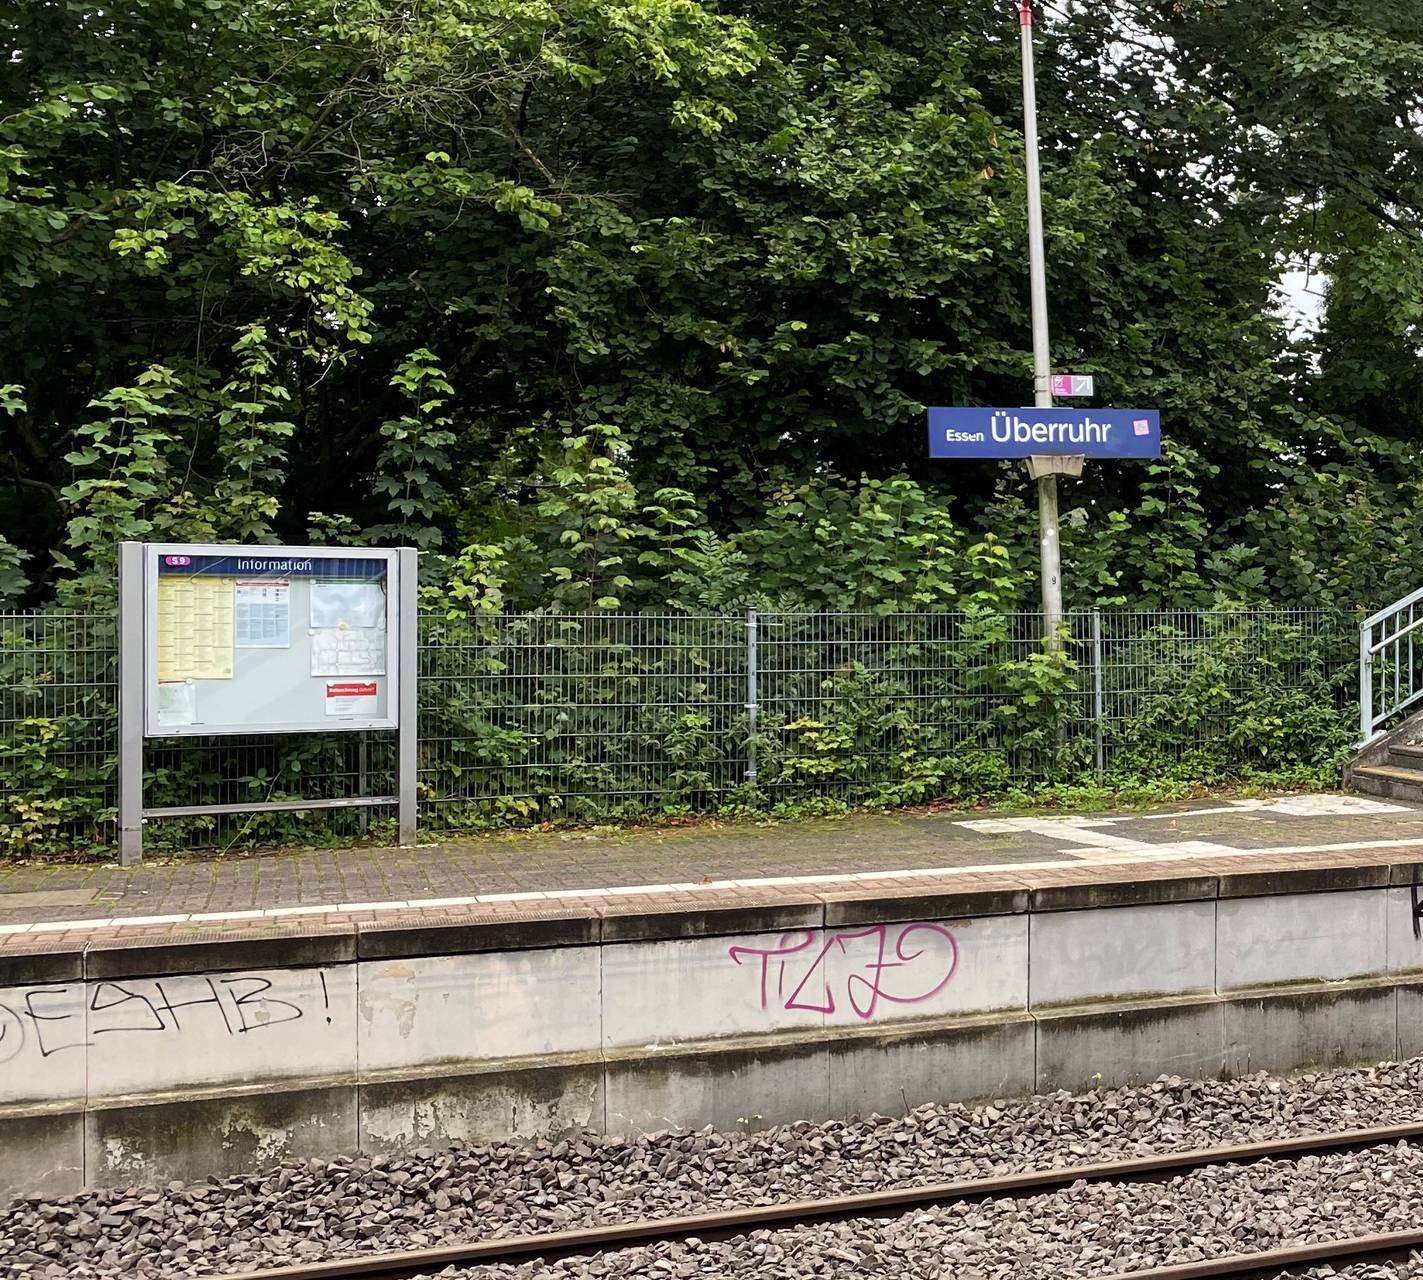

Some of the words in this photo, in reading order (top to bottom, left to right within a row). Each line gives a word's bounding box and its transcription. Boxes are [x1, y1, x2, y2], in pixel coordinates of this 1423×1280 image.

[946, 429, 984, 442] Essen
[991, 411, 1111, 442] Überruhr
[237, 558, 312, 571] Information
